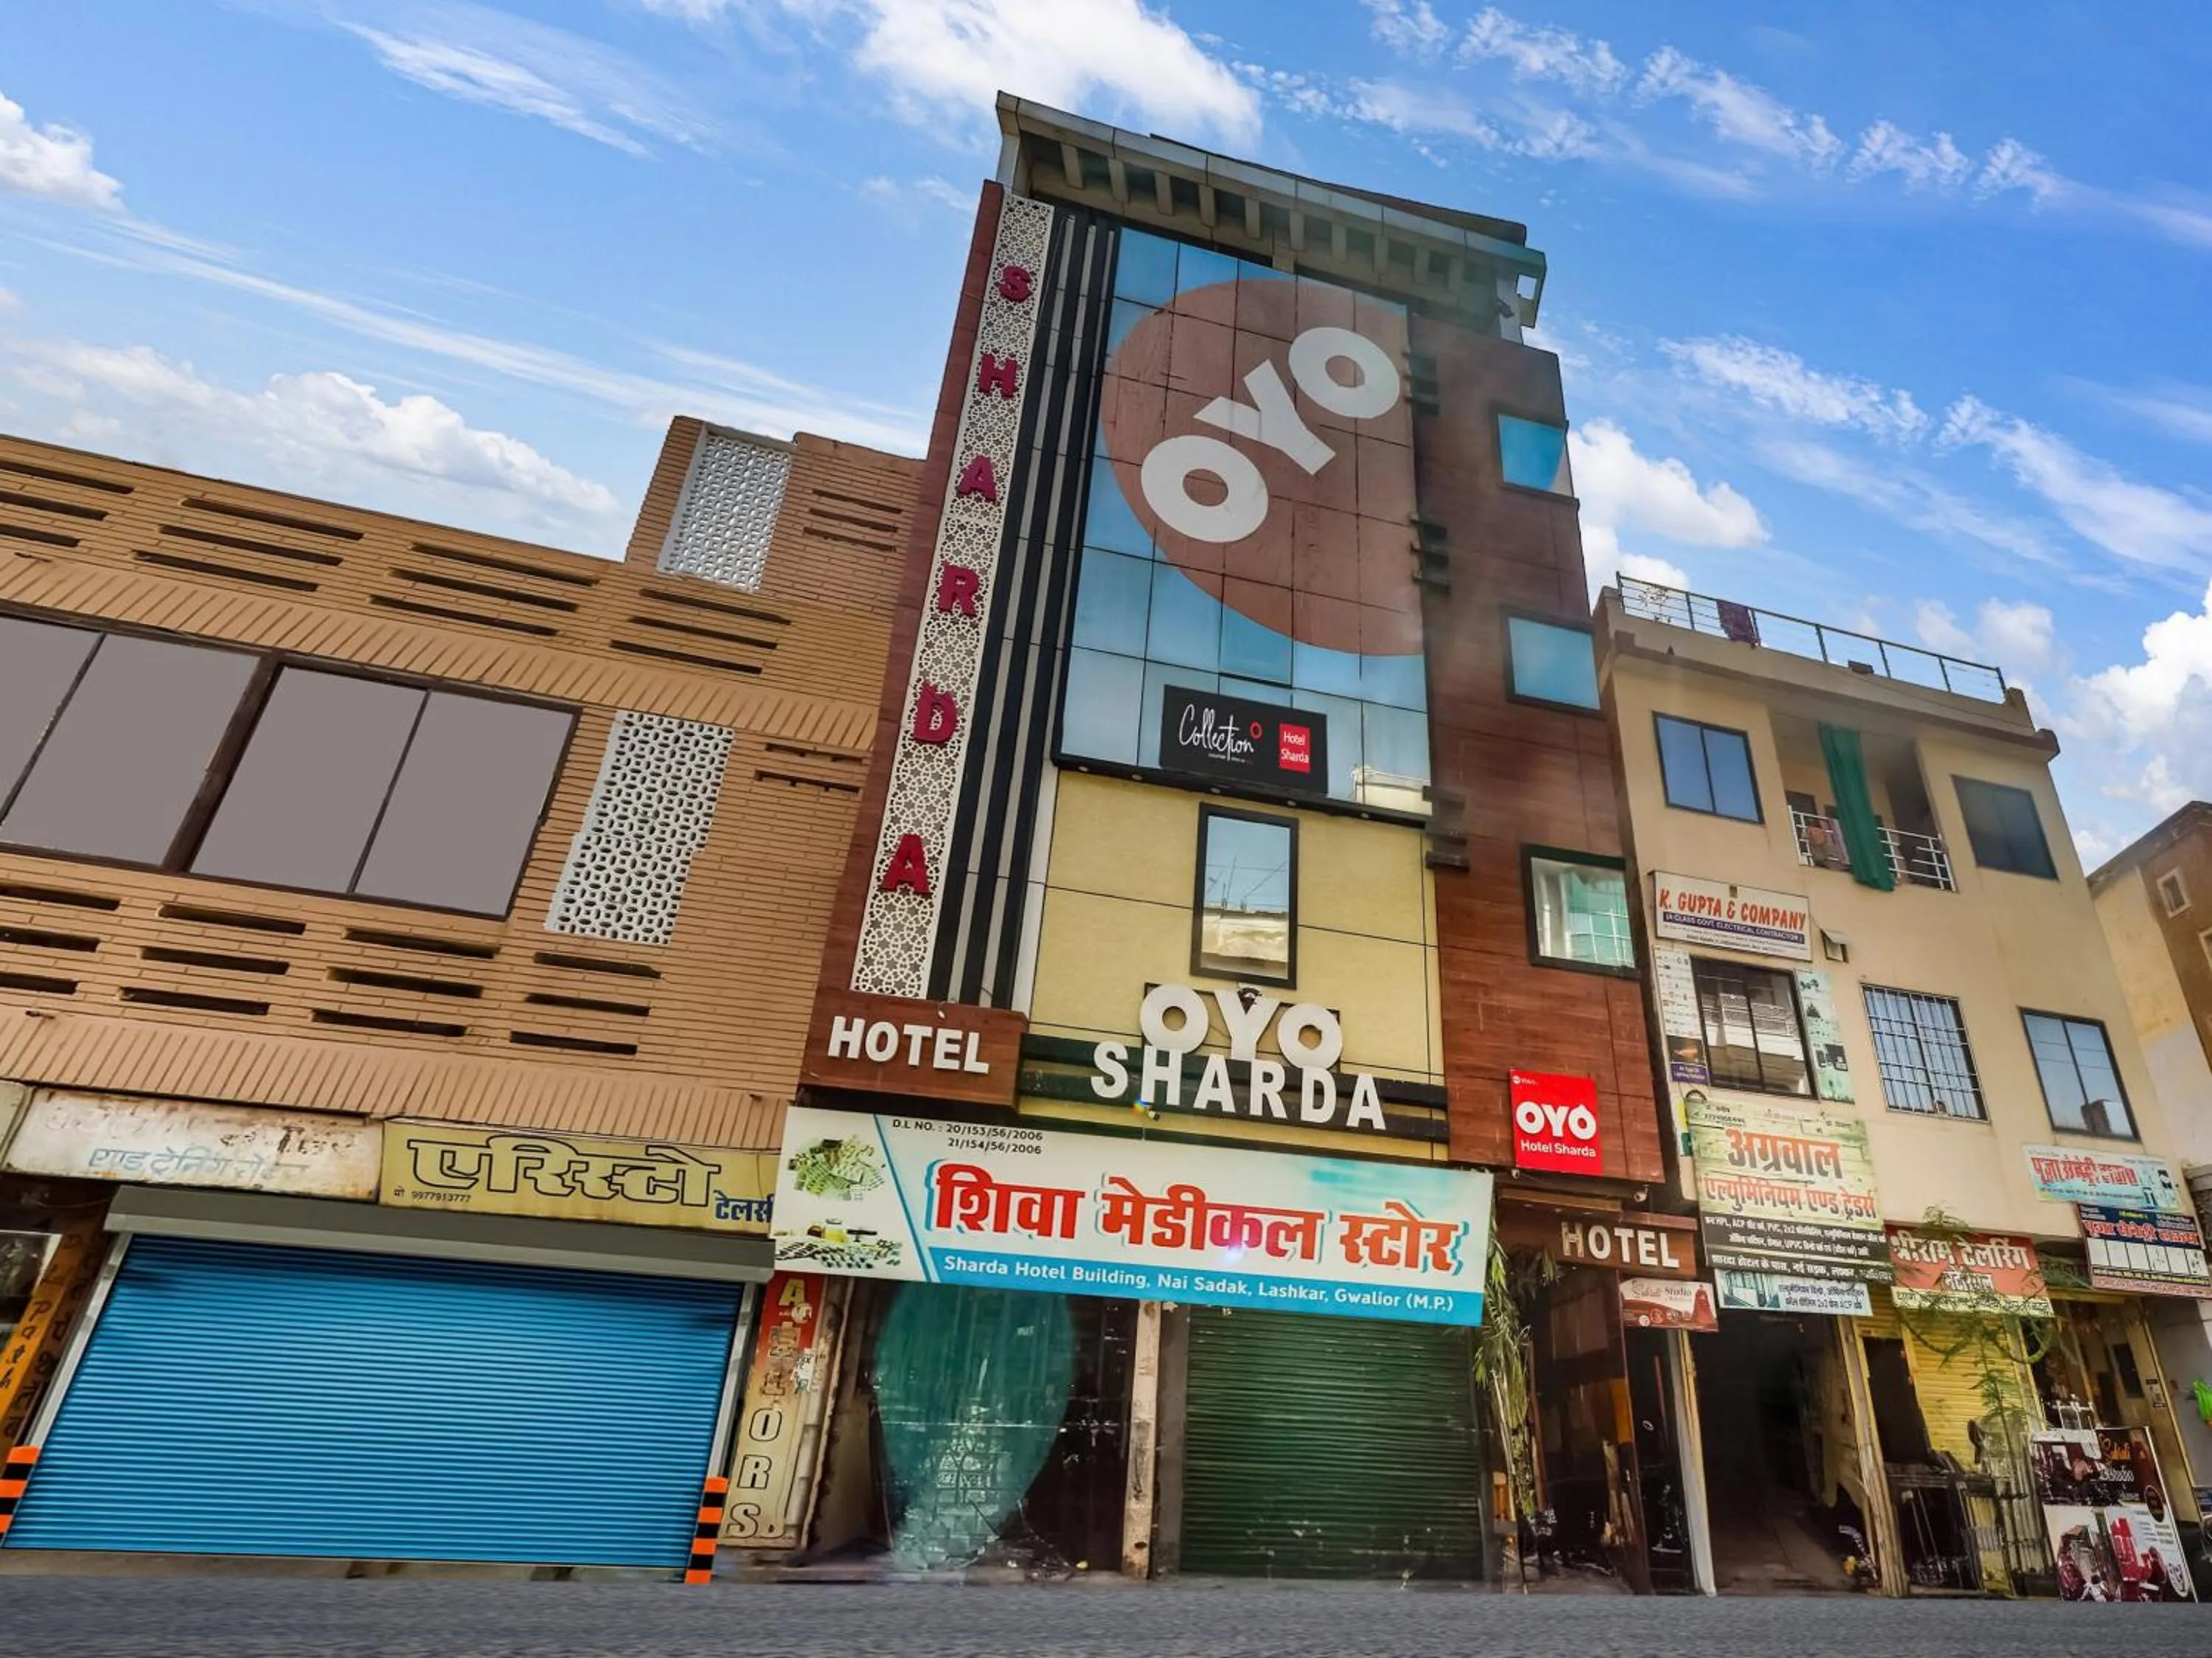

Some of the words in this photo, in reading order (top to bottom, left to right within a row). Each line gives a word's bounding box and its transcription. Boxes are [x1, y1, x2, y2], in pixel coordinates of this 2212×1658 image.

[1141, 326, 1401, 544] OYO
[1179, 704, 1254, 762] Collection
[1280, 748, 1310, 763] Sharda
[1283, 731, 1306, 746] Hotel
[1659, 889, 1672, 909] K.
[1677, 892, 1722, 918] GUPTA
[1727, 901, 1736, 920] &
[1741, 902, 1806, 931] COMPANY
[1674, 914, 1696, 924] CLASS
[1717, 920, 1755, 934] ELECTRICAL
[827, 1016, 990, 1075] HOTEL
[1140, 983, 1343, 1069] OYO
[1091, 1041, 1386, 1130] SHARDA
[946, 1123, 1043, 1141] 20/153/56/2006
[948, 1137, 1042, 1154] 21/154/56/2006
[1516, 1101, 1596, 1140] OYO
[407, 1134, 721, 1207] एरिस्टो
[1520, 1139, 1552, 1153] Hotel
[1554, 1142, 1596, 1157] Sharda
[1725, 1127, 1843, 1179] अग्रवाल
[931, 1161, 1085, 1240] शिवा
[1099, 1175, 1325, 1260] मेडीकल
[1340, 1201, 1463, 1273] स्टोर
[1561, 1221, 1680, 1269] HOTEL
[944, 1256, 1008, 1276] Sharda
[1015, 1260, 1065, 1280] Hotel
[1072, 1266, 1151, 1288] Building,
[1157, 1274, 1188, 1290] Nai
[1194, 1277, 1252, 1297] Sadak,
[1259, 1284, 1329, 1304] Lashkar,
[1334, 1288, 1400, 1308] Gwalior
[1406, 1293, 1454, 1313] (M.P.)
